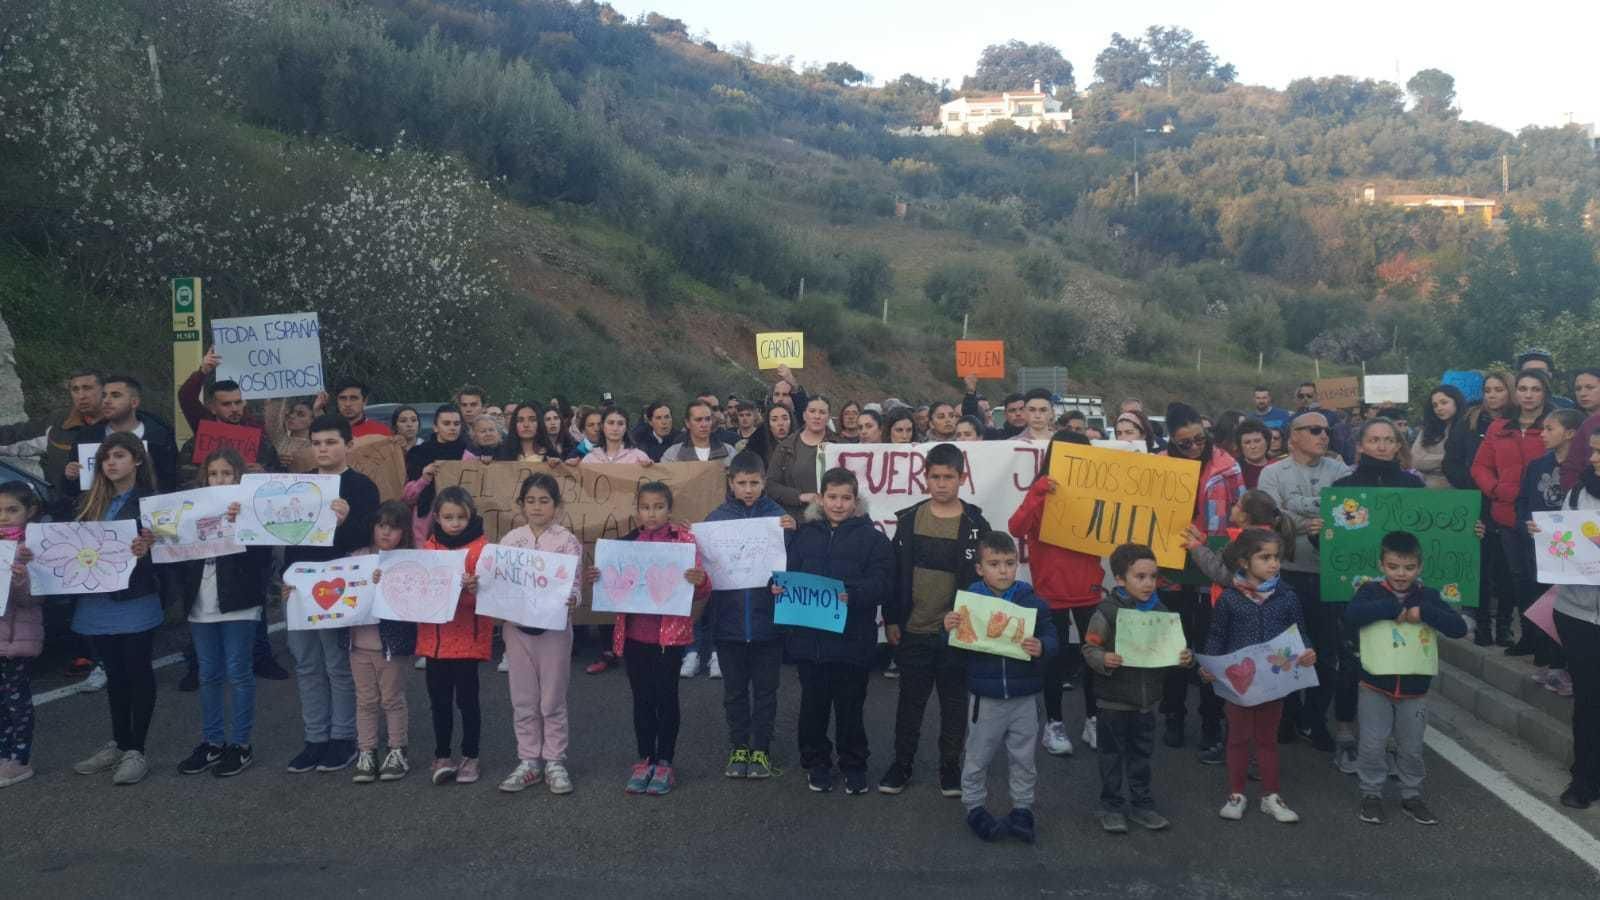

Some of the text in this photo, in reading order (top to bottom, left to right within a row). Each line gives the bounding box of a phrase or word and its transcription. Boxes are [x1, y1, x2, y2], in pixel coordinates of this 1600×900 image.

[213, 318, 320, 344] TODA ESPAÑA
[248, 348, 281, 367] CON
[761, 336, 800, 360] CARIÑO
[959, 351, 1000, 368] JULEN
[458, 468, 494, 499] EL
[1064, 455, 1120, 493] TODOS
[1123, 465, 1193, 505] SOMOS
[496, 547, 545, 571] MUCHO
[495, 567, 548, 589] ANIMO
